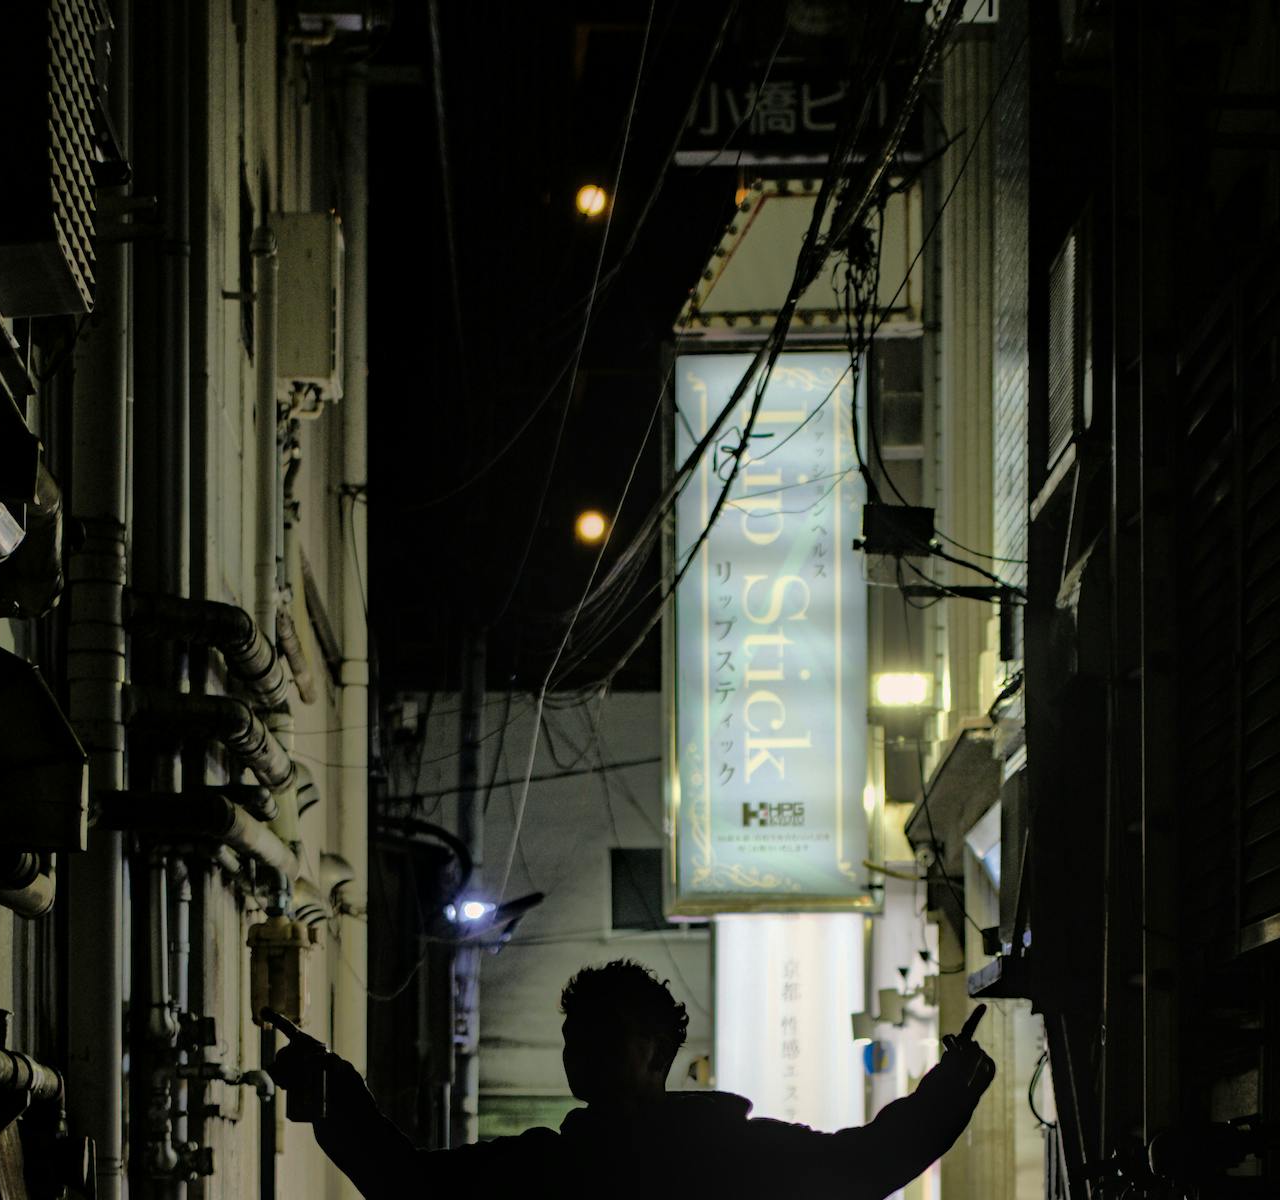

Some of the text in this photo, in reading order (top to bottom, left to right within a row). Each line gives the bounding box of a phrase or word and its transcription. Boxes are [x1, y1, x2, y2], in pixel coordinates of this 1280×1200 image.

[714, 560, 737, 787] リップスティック
[743, 573, 812, 784] Stick
[769, 802, 805, 816] HPG
